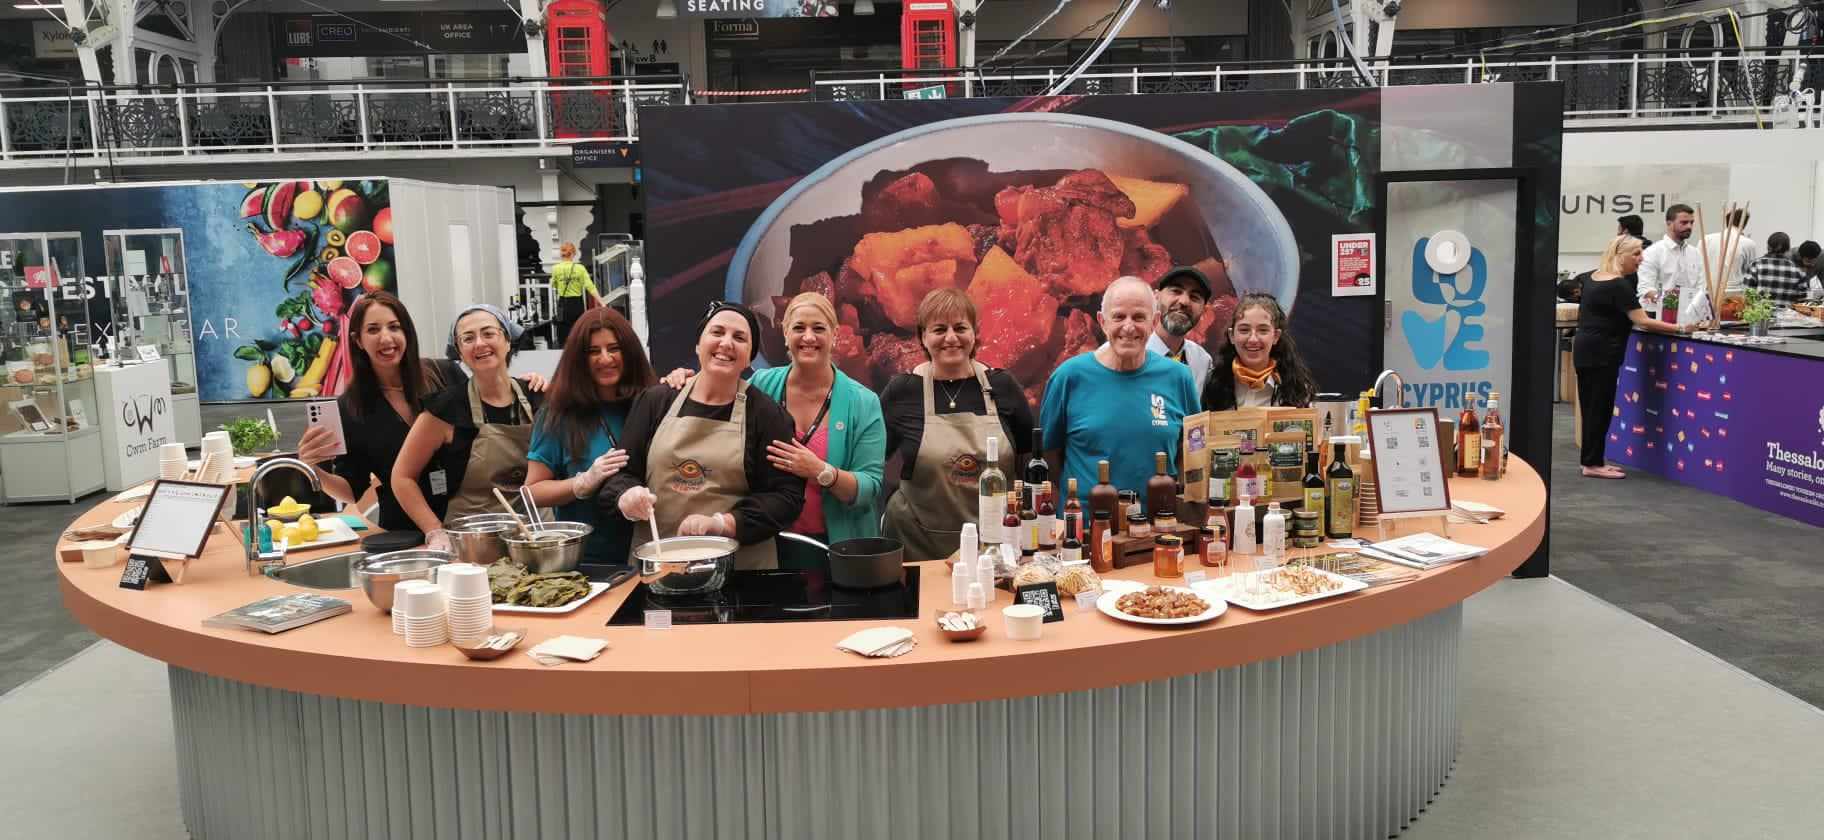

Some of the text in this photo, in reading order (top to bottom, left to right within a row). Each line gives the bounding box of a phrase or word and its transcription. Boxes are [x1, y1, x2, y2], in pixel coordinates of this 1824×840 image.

[687, 0, 764, 11] SEATING
[320, 26, 353, 36] CREO
[713, 20, 753, 33] Forma
[443, 31, 472, 39] OFFICE
[1339, 241, 1369, 249] UNDER
[1767, 442, 1824, 471] Thessalo
[1766, 460, 1786, 476] Many
[1787, 468, 1815, 483] stories,
